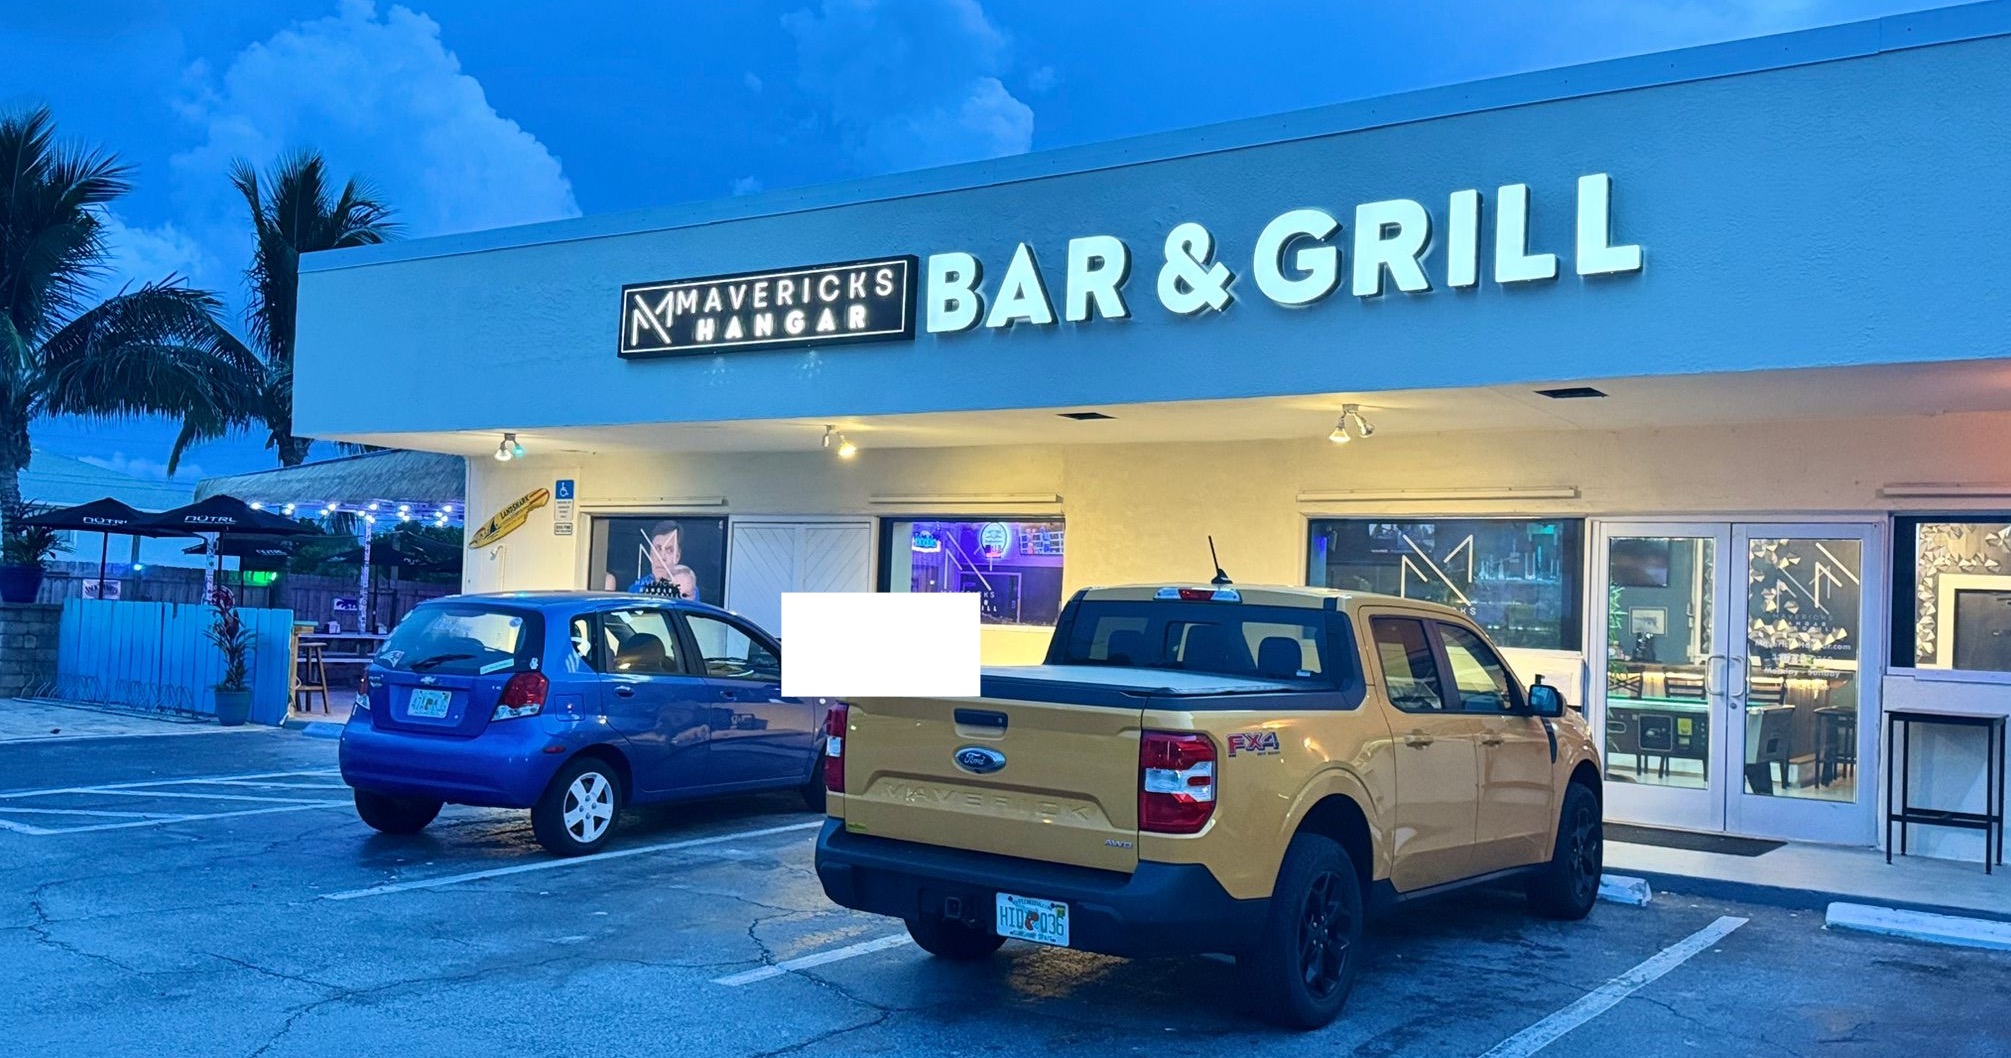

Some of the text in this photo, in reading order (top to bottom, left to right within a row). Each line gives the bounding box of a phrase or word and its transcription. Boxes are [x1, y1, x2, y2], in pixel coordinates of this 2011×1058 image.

[927, 173, 1642, 333] BAR & GRILL
[675, 268, 893, 316] MAVERICKS
[695, 304, 867, 342] HANGAR
[964, 751, 986, 766] Ford
[1227, 732, 1280, 758] FX4
